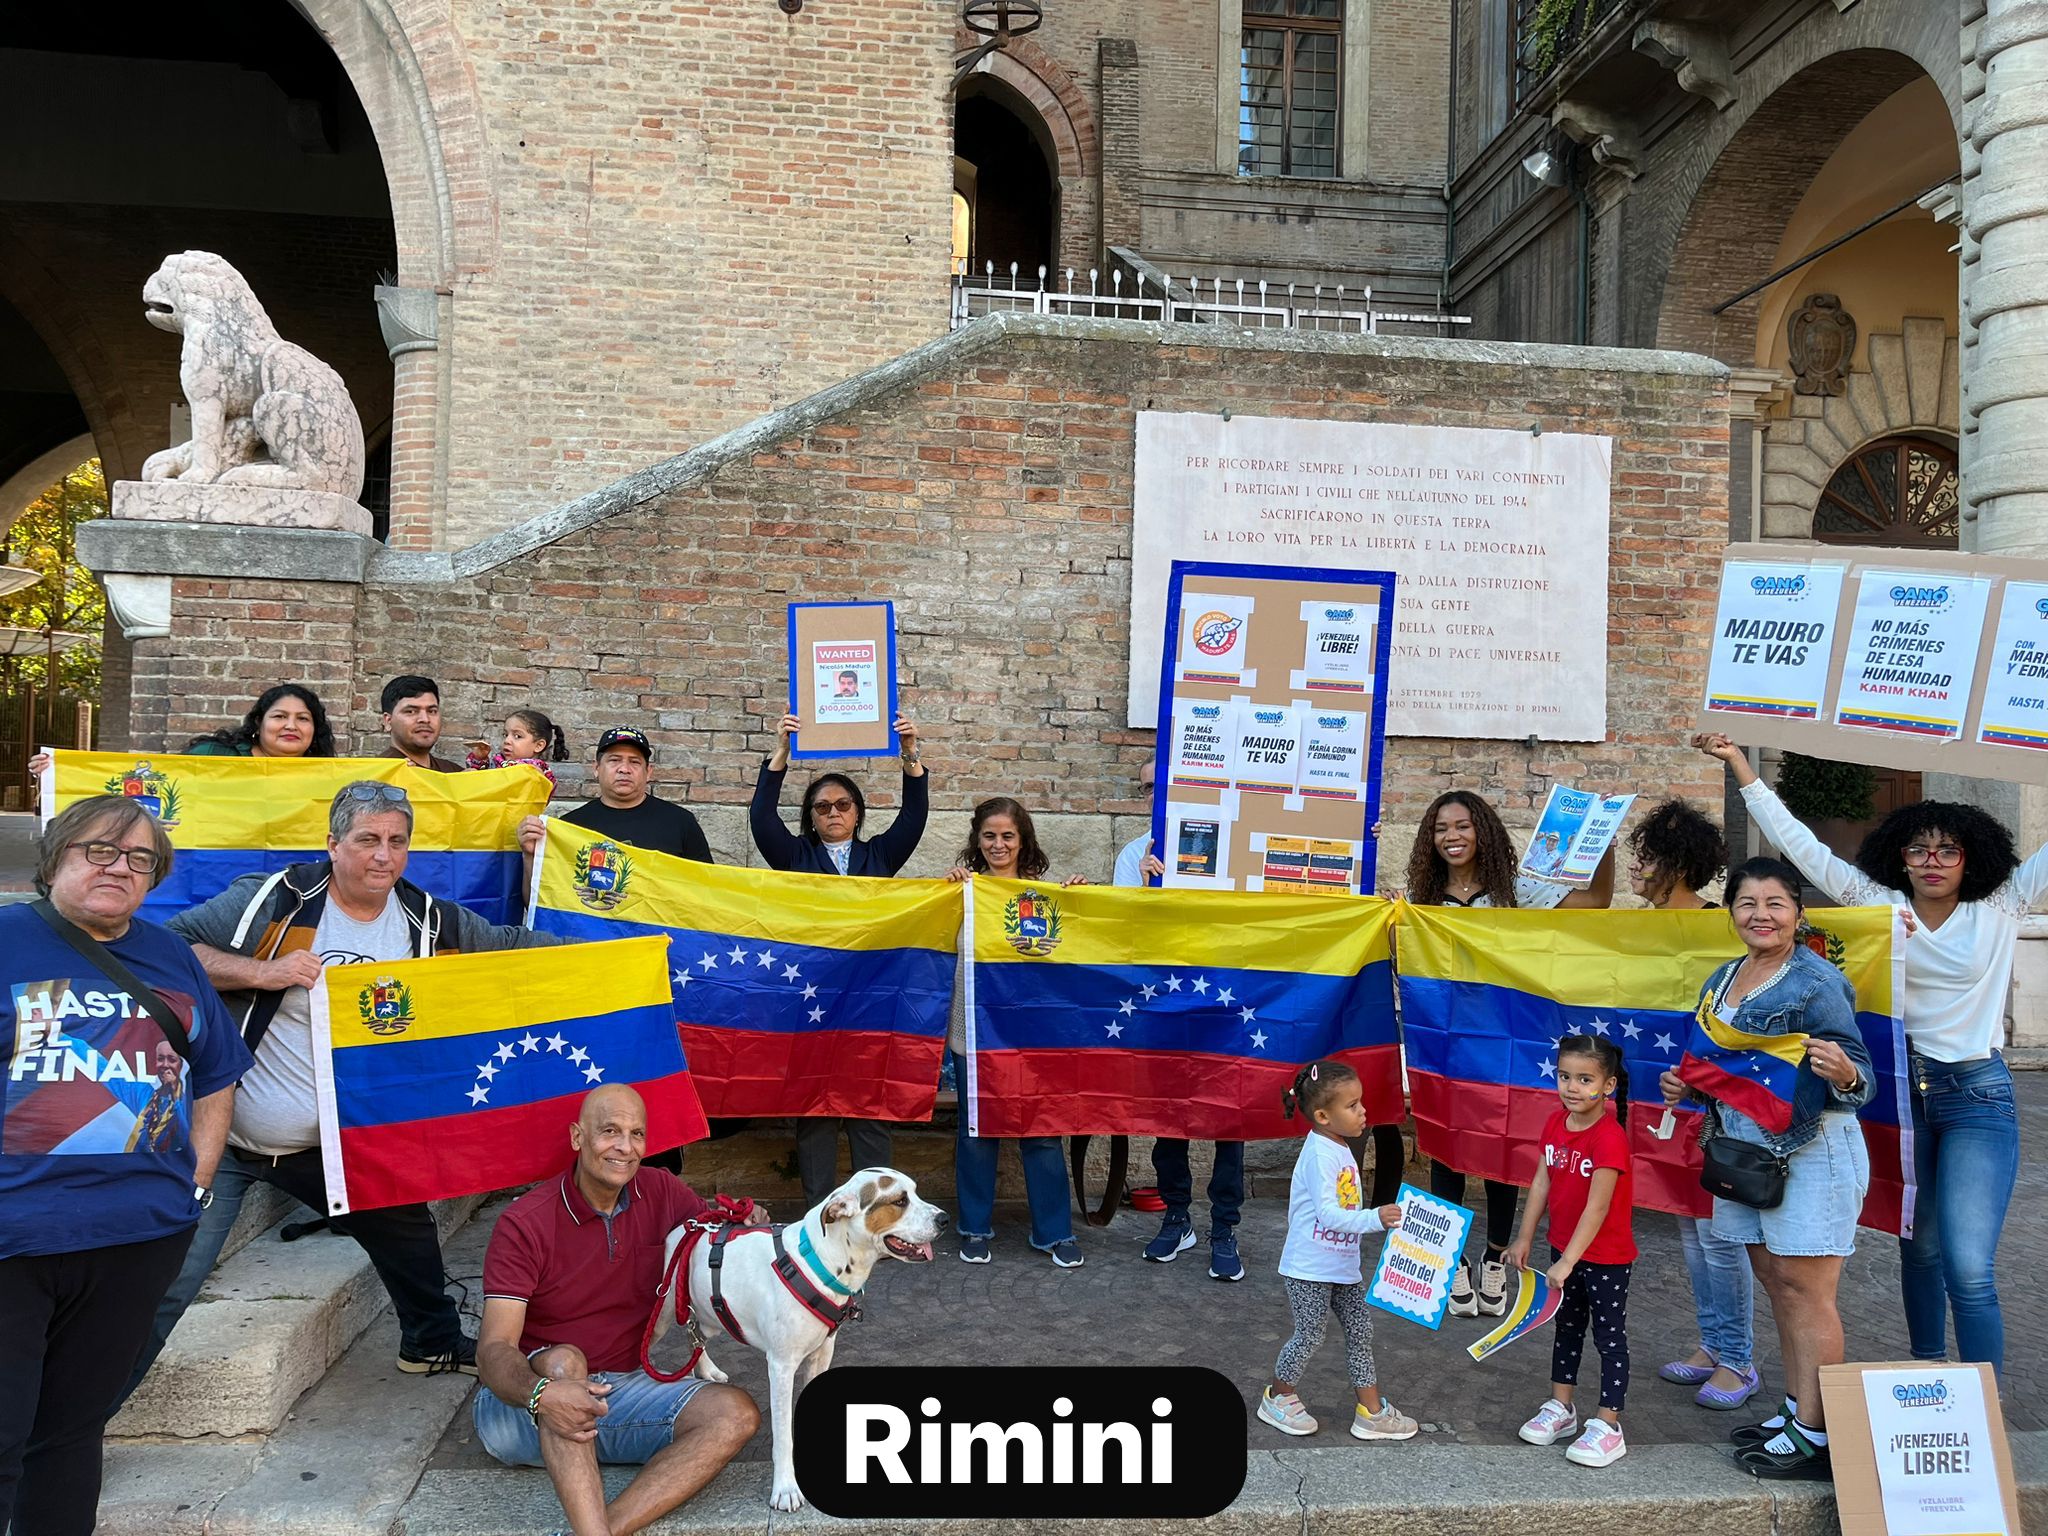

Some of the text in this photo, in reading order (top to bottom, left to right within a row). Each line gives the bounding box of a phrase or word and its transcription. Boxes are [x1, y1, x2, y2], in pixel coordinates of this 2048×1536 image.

[1187, 456, 1209, 468] PER
[1218, 458, 1289, 472] RICORDARE
[1300, 462, 1344, 474] SEMPRE
[1366, 466, 1421, 478] SOLDATI
[1429, 468, 1448, 480] DEI
[1456, 470, 1484, 481] VARI
[1492, 472, 1565, 485] CONTINENTI
[1235, 483, 1298, 496] PARTIGIANI
[1317, 486, 1352, 498] CIVILI
[1358, 488, 1380, 500] CHE
[1387, 489, 1468, 504] NELL'AUTUNNO
[1476, 494, 1496, 506] DEL
[1503, 496, 1527, 508] 1944
[1260, 508, 1490, 529] SACRIFICARONO IN QUESTA TERRA
[1204, 530, 1218, 542] LA
[1228, 531, 1264, 543] LORO
[1274, 533, 1301, 544] VITA
[1310, 535, 1333, 546] PER
[1341, 536, 1357, 547] LA
[1426, 540, 1431, 550] E
[1440, 540, 1456, 552] LA
[1464, 542, 1546, 556] DEMOCRAZIA
[1419, 575, 1458, 588] DALLA
[1467, 576, 1550, 591] DISTRUZIONE
[1751, 574, 1806, 590] GANÓ
[1890, 586, 1949, 603] GANÓ
[1400, 598, 1470, 611] SUA GENTE
[1894, 600, 1941, 608] VENEZUELA
[1325, 608, 1353, 618] GANÓ
[1399, 622, 1495, 636] DELLA GUERRA
[1724, 618, 1824, 644] MADURO
[1871, 619, 1930, 636] NO MÁS
[1316, 632, 1360, 642] ¡VENEZUELA
[1868, 634, 1946, 654] CRÍMENES
[1320, 641, 1358, 654] LIBRE!
[2015, 640, 2036, 650] CON
[819, 650, 870, 658] WANTED
[1429, 648, 1441, 658] DI
[1450, 648, 1481, 660] PACE
[1490, 649, 1561, 663] UNIVERSALE
[1732, 644, 1808, 666] TE VAS
[1865, 651, 1924, 668] DE LESA
[2006, 662, 2016, 674] Y
[1862, 666, 1952, 687] HUMANIDAD
[1400, 688, 1453, 698] SETTEMBRE
[1461, 690, 1482, 698] 1979
[1860, 683, 1948, 700] KARIM KHAN
[1412, 702, 1442, 710] DELLA
[1450, 702, 1508, 712] LIBERAZIONE
[1532, 705, 1561, 713] RIMINI
[2008, 696, 2044, 710] HASTA
[1192, 706, 1220, 716] GANÓ
[1255, 712, 1284, 722] GANÓ
[1318, 716, 1347, 726] GANÓ
[1196, 724, 1212, 734] MÁS
[1184, 733, 1220, 744] CRÍMENES
[1242, 736, 1294, 751] MADURO
[1184, 742, 1212, 752] DE LESA
[1308, 744, 1356, 754] MARÍA CORINA
[1182, 752, 1225, 762] HUMANIDAD
[1247, 751, 1287, 764] TE VAS
[1312, 753, 1346, 762] EDMUNDO
[20, 1021, 72, 1050] EL
[10, 1049, 158, 1082] FINAL
[1406, 1200, 1451, 1232] Edmundo
[1402, 1216, 1446, 1247] González
[1391, 1234, 1446, 1270] Presidente
[1390, 1254, 1436, 1284] eletto del
[1384, 1266, 1432, 1300] Venezuela
[1892, 1380, 1947, 1400] GANÓ
[1900, 1396, 1944, 1408] VENEZUELA
[1890, 1432, 1969, 1452] ¡VENEZUELA
[1904, 1450, 1970, 1475] LIBRE!
